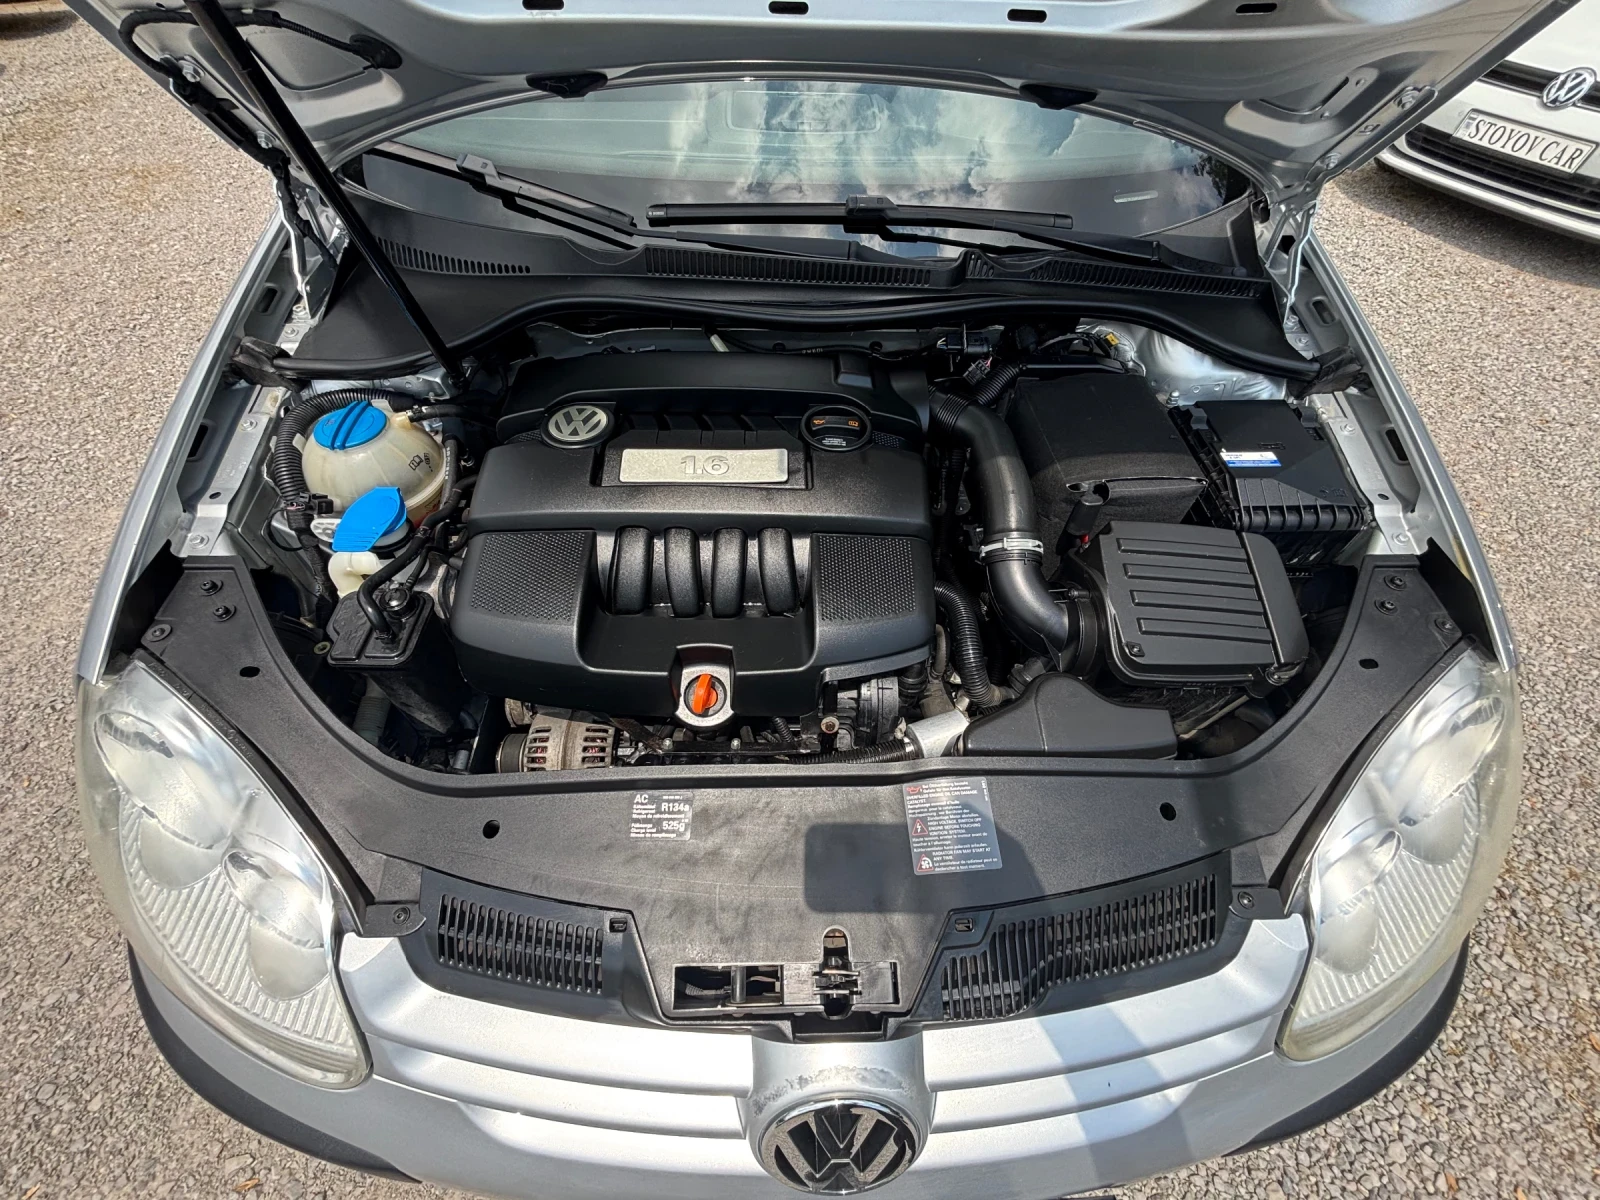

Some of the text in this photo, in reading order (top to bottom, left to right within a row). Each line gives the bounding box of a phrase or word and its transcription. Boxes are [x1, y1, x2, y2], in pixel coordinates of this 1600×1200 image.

[1468, 118, 1584, 170] STOYOV CAR
[680, 454, 730, 476] 1.6
[634, 794, 648, 803] AC
[662, 803, 689, 811] R134a
